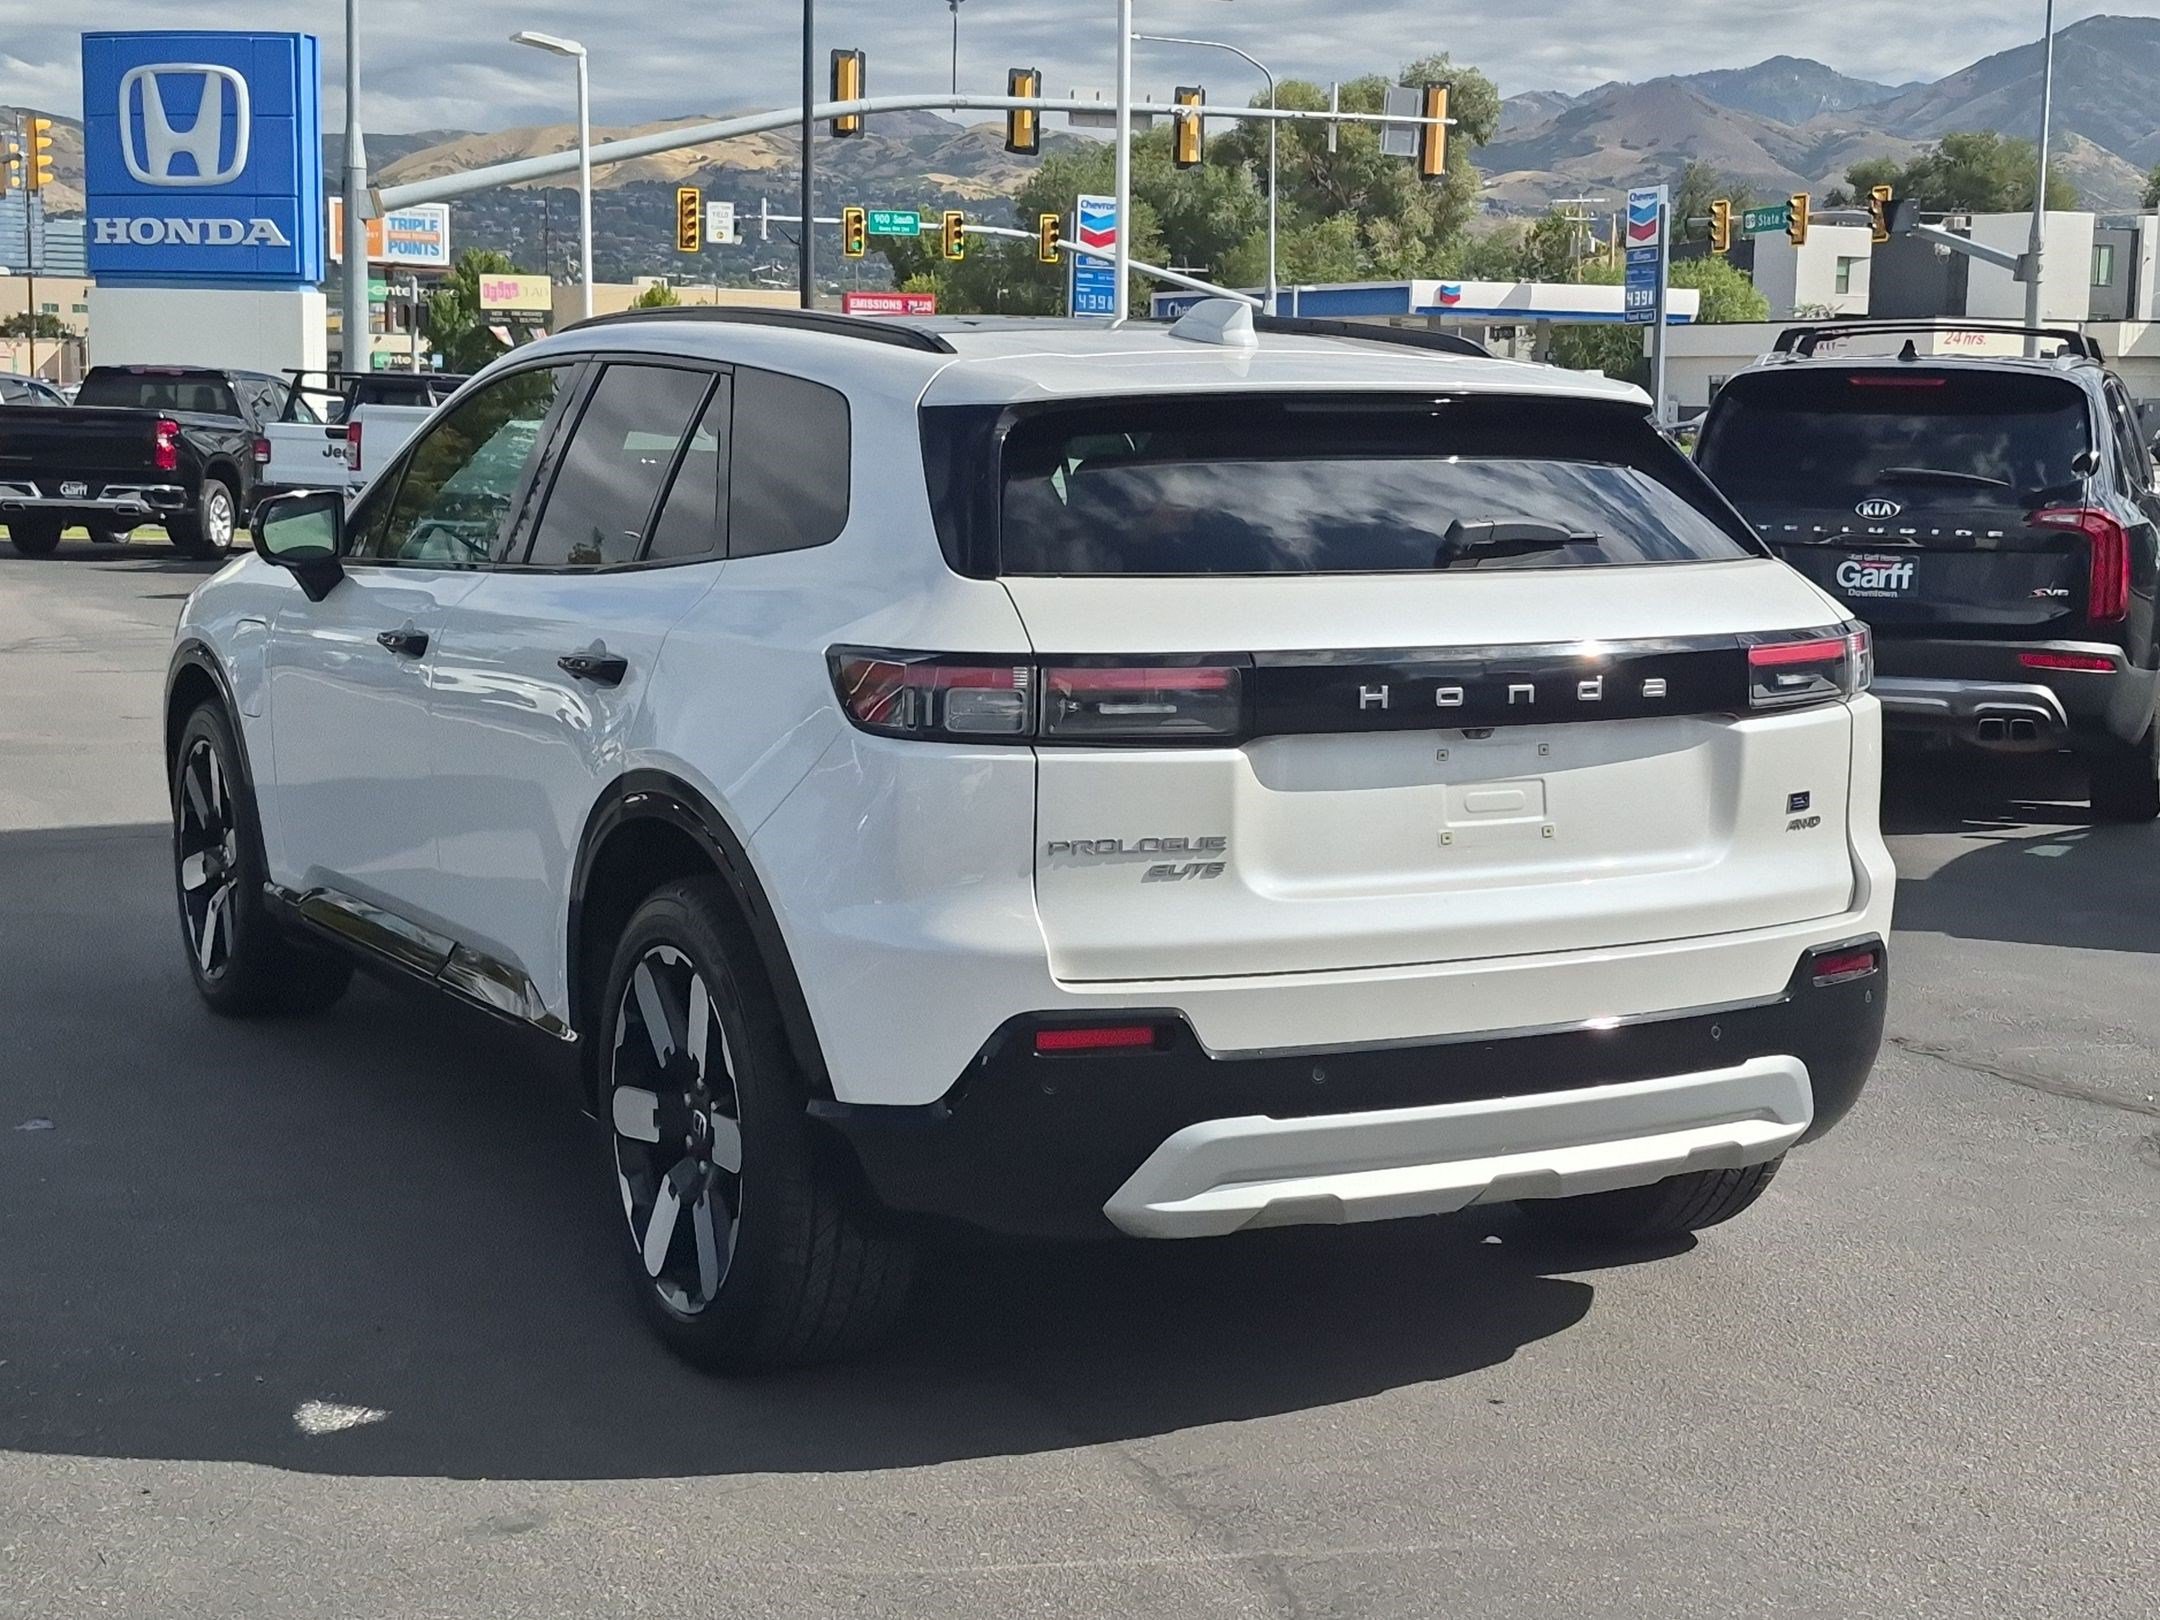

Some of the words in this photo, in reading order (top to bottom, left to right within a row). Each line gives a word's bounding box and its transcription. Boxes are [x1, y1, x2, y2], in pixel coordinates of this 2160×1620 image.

[388, 217, 438, 232] TRIPLE
[874, 213, 890, 224] 900
[1758, 213, 1779, 227] State
[93, 217, 291, 247] HONDA
[387, 240, 440, 257] POINTS
[850, 298, 903, 310] EMISSIONS
[1943, 331, 1961, 346] 24
[1862, 502, 1893, 517] KIA
[1836, 560, 1914, 589] Garff
[1848, 588, 1898, 598] Downtown
[1047, 836, 1227, 857] PROLOGUE
[1149, 861, 1227, 880] ELITE
